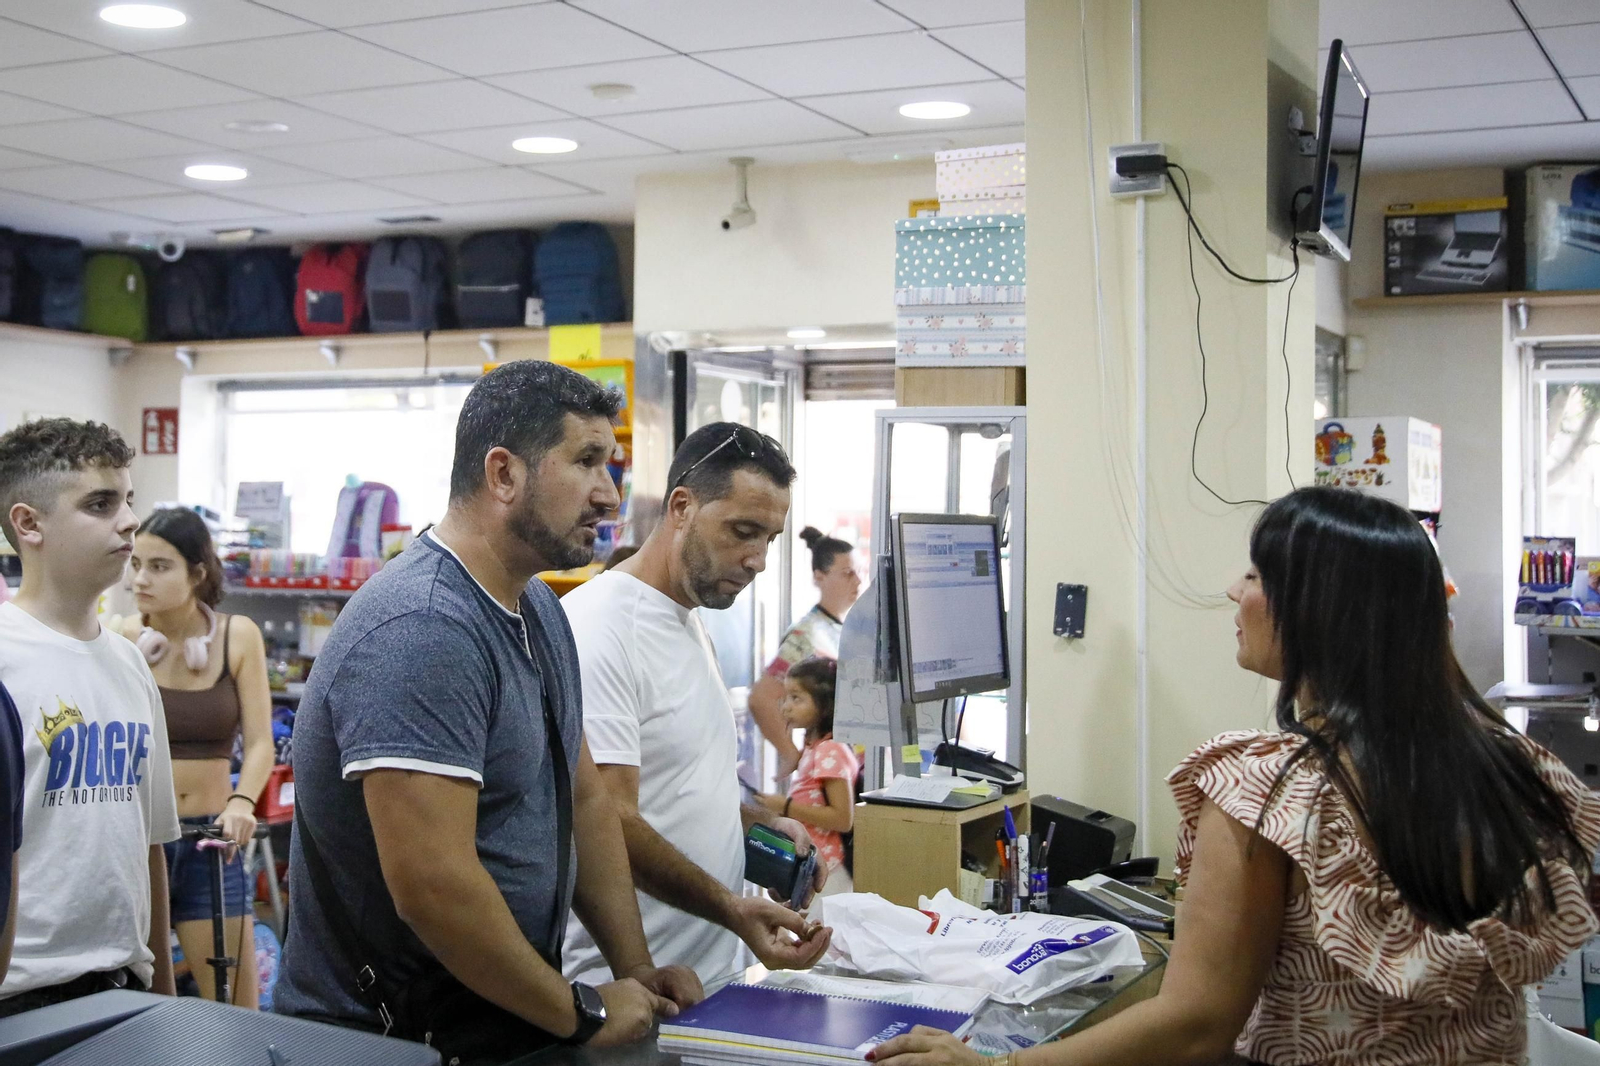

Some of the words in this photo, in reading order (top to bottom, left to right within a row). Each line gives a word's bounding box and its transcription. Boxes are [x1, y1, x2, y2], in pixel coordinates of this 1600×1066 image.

[45, 721, 150, 791] BIGGIE
[42, 791, 64, 808] THE
[72, 787, 133, 804] NOTORIOUS
